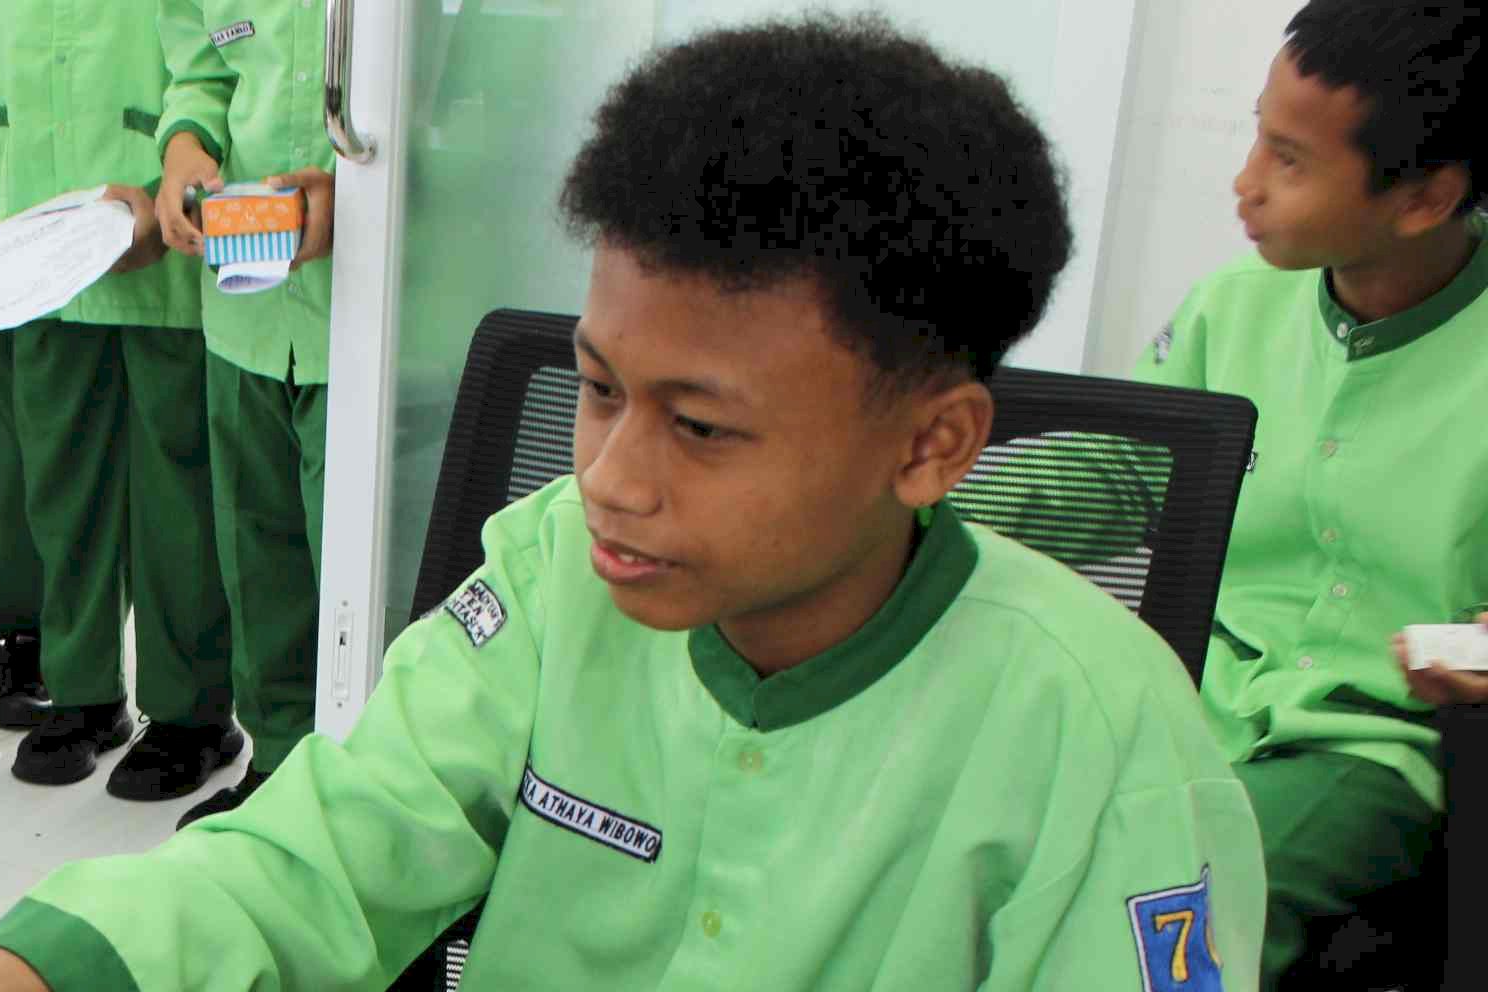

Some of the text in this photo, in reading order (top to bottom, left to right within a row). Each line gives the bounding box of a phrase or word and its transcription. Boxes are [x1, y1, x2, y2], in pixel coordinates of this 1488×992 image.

[538, 791, 595, 828] ATHAYA
[598, 815, 658, 853] WIBOWO
[1151, 909, 1220, 983] 7
